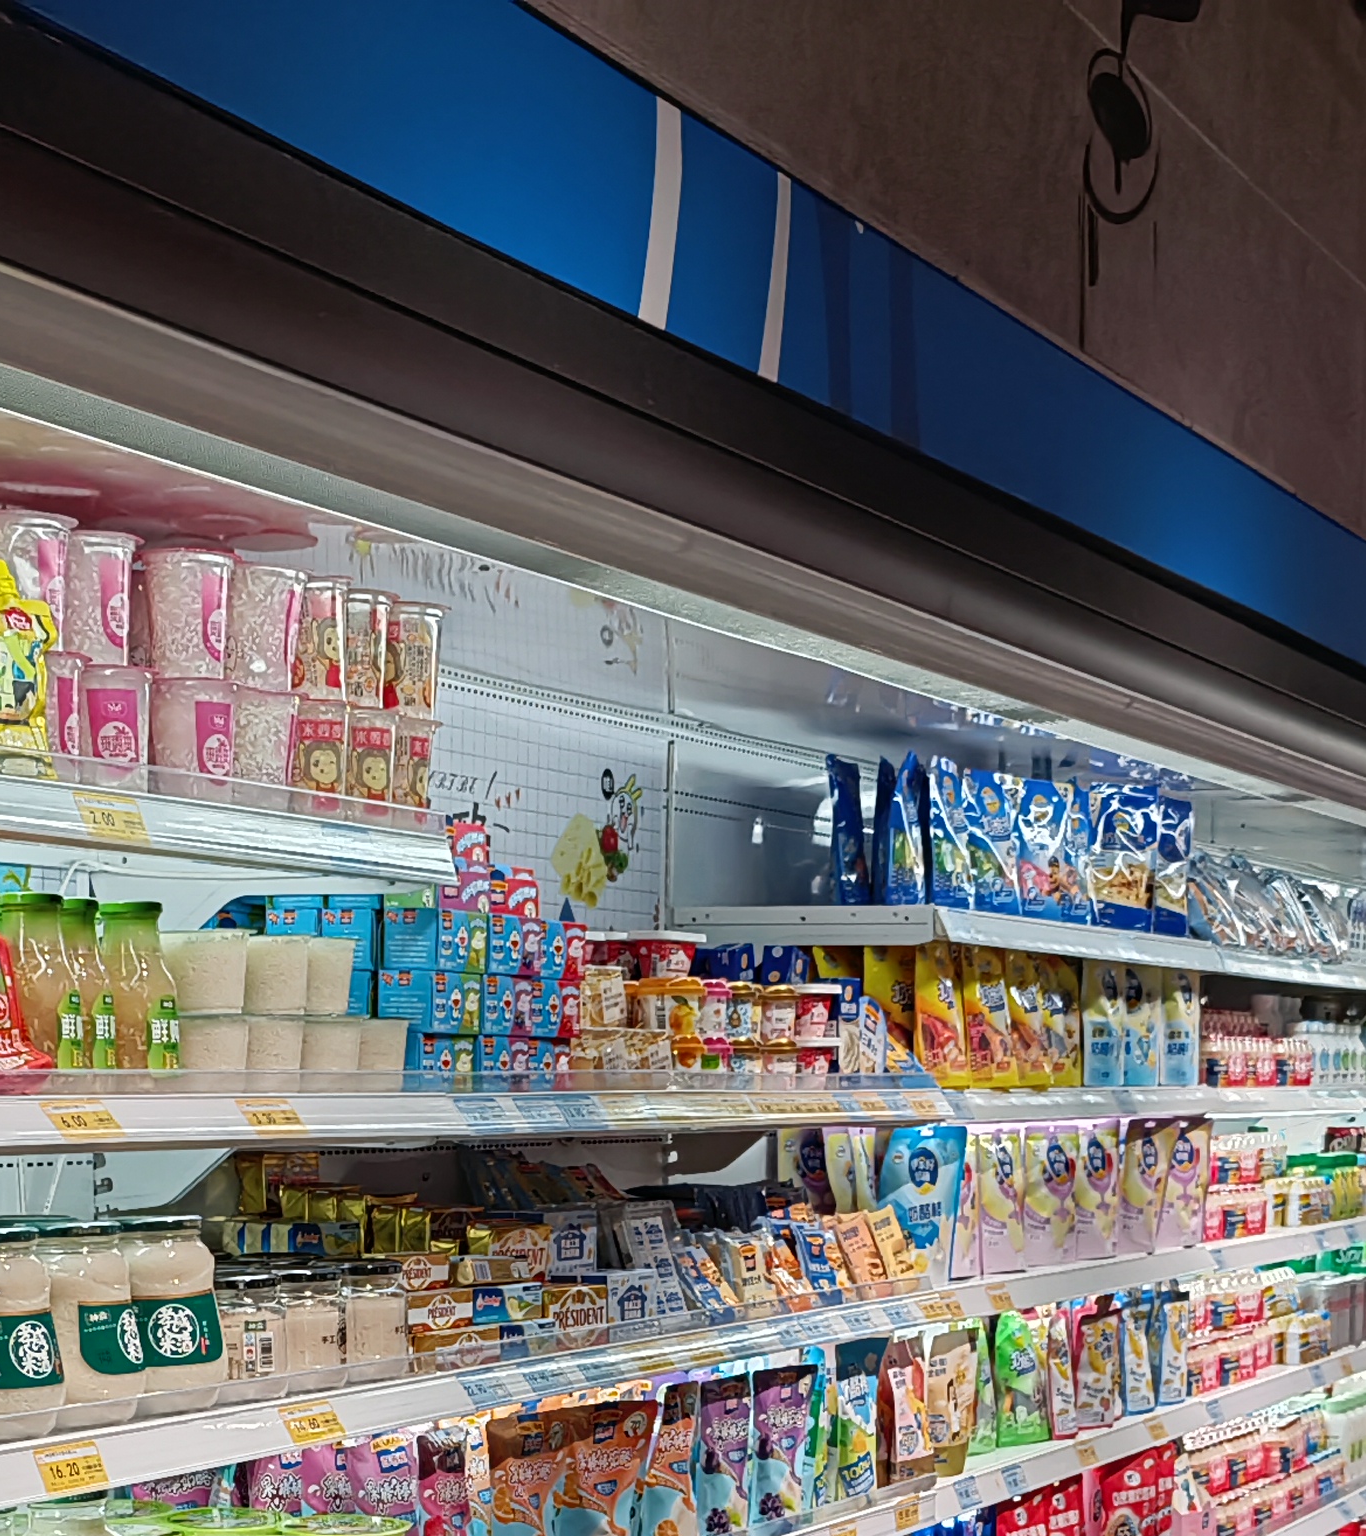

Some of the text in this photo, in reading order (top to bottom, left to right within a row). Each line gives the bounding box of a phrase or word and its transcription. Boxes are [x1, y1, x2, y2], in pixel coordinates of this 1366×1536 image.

[90, 811, 115, 828] 2.00
[60, 1114, 88, 1129] 6.00
[402, 1266, 432, 1280] PRÉSIDENT
[427, 1305, 457, 1318] PRÉSIDENT
[553, 1306, 605, 1330] PRÉSIDENT
[49, 1461, 81, 1480] 16.20
